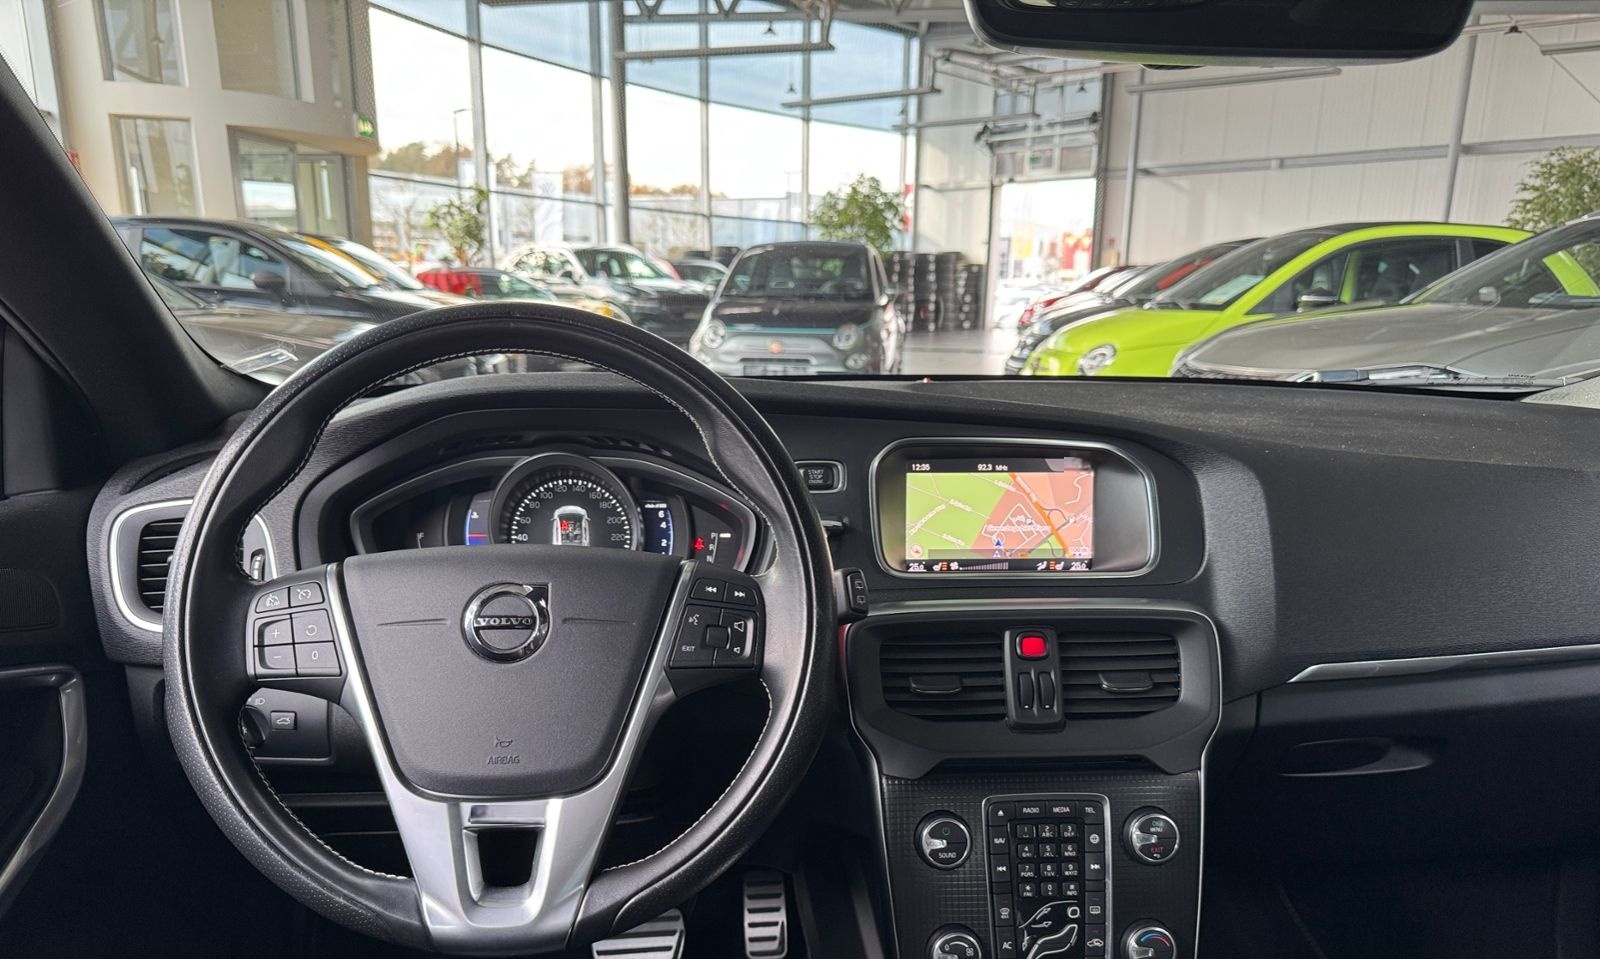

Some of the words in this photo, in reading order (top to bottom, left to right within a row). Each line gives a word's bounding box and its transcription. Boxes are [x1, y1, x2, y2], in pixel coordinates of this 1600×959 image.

[529, 501, 540, 509] 80
[600, 501, 612, 509] 180
[658, 510, 664, 518] 6
[517, 533, 528, 541] 40
[611, 533, 626, 541] 220
[477, 618, 533, 626] VOLVO
[488, 756, 520, 765] AIRBAG
